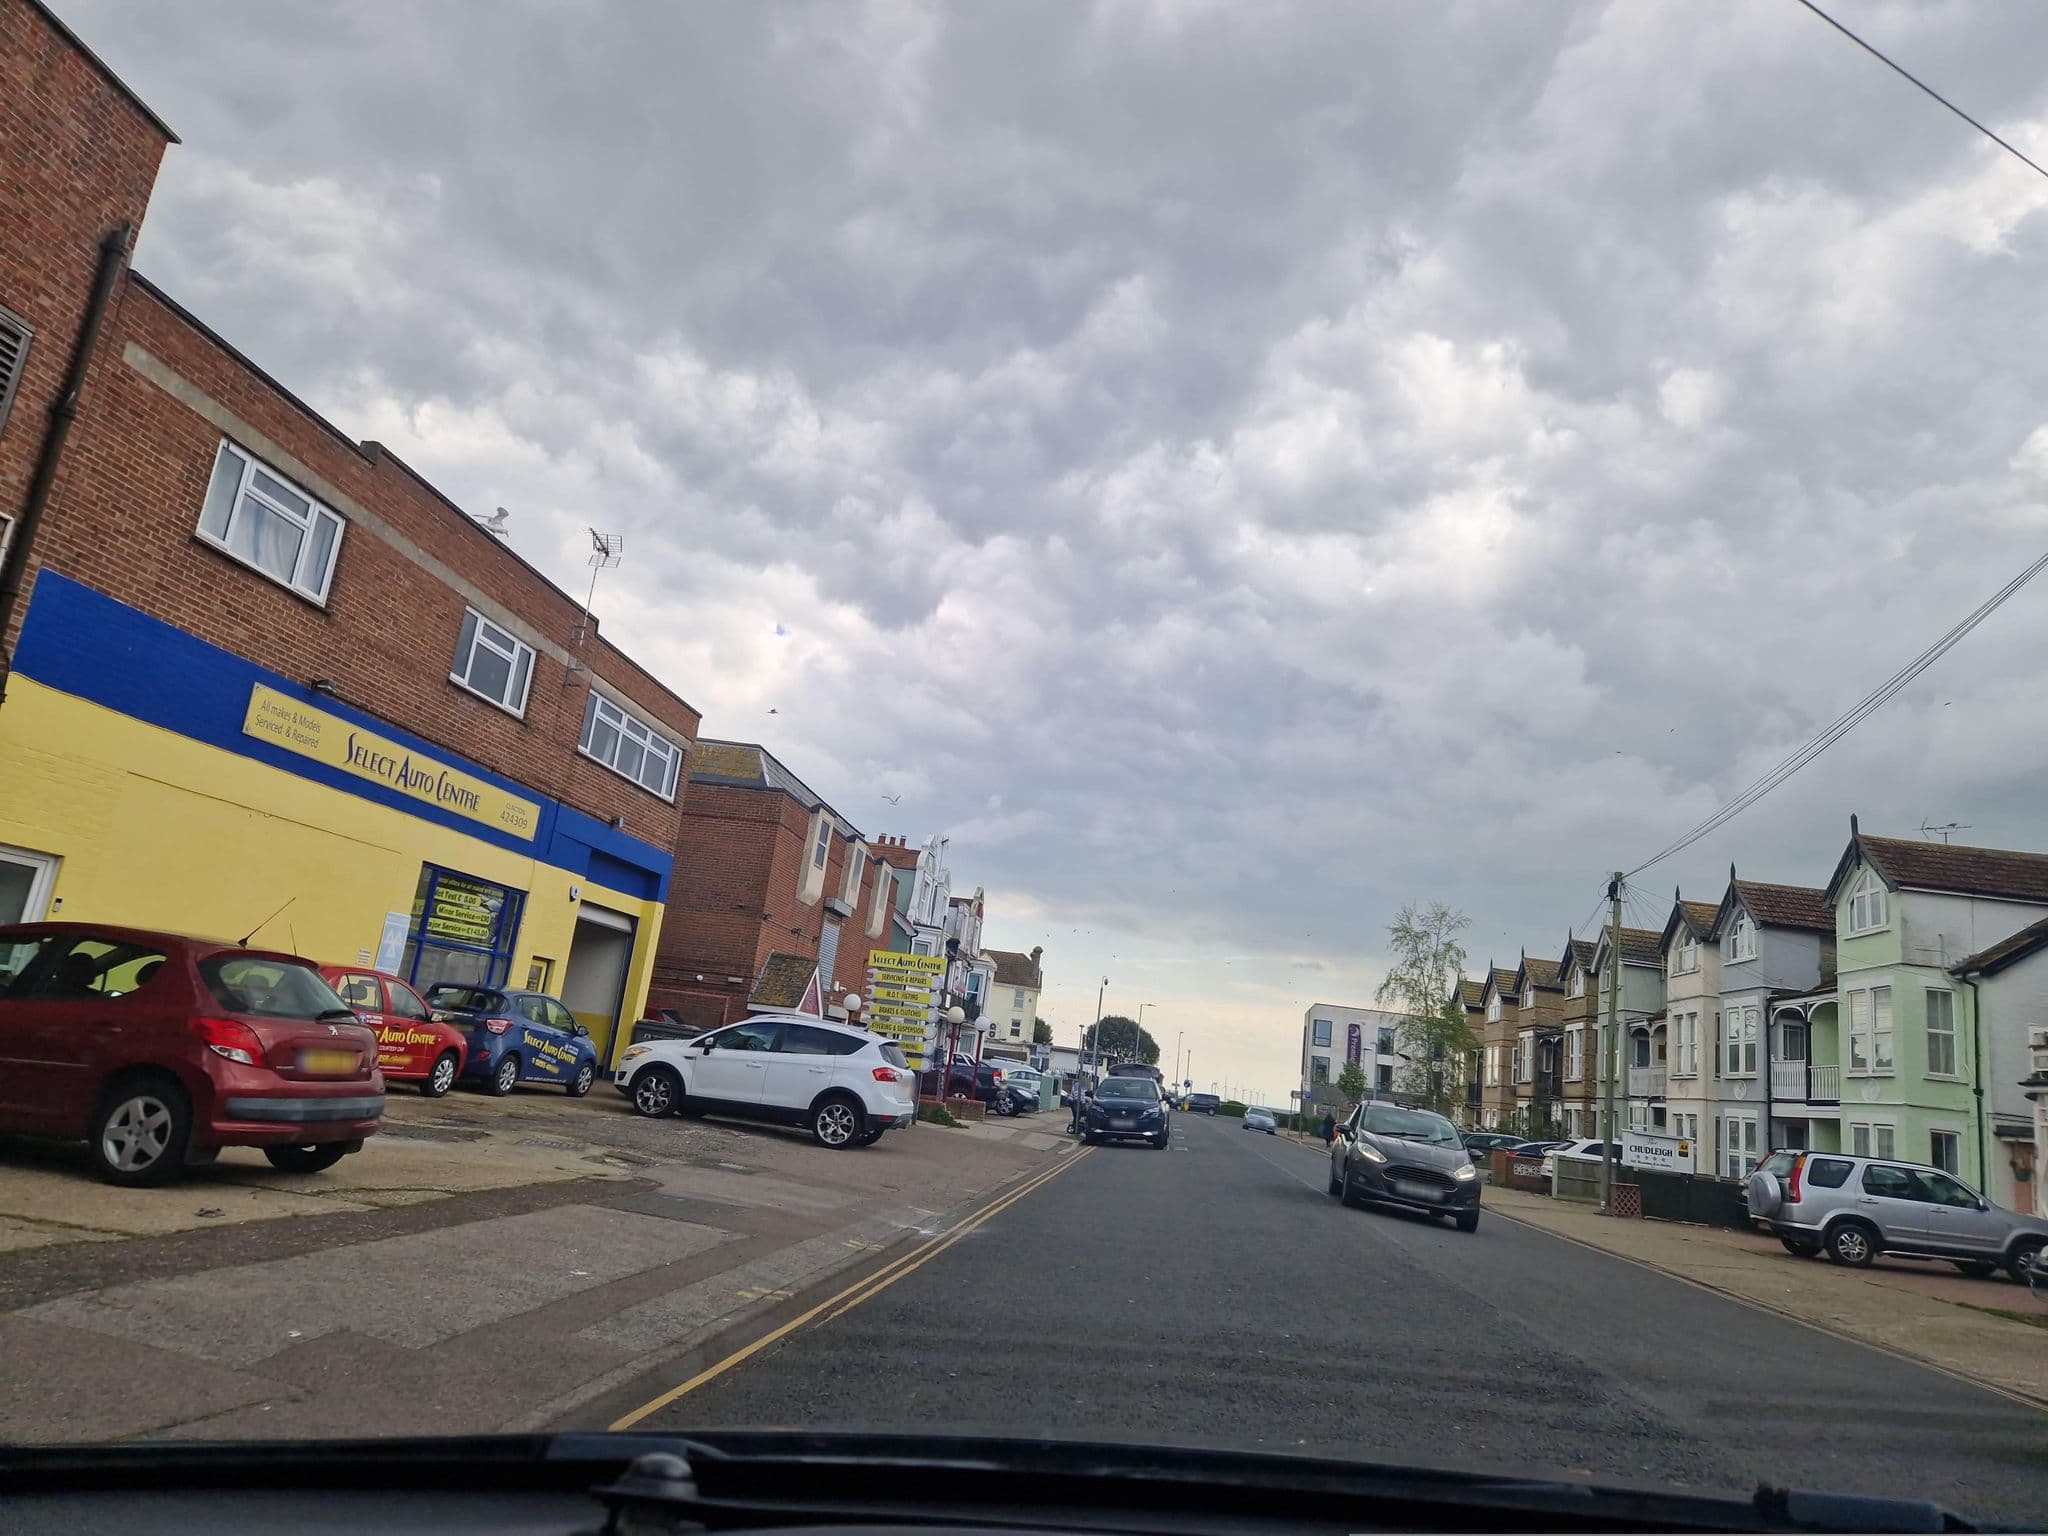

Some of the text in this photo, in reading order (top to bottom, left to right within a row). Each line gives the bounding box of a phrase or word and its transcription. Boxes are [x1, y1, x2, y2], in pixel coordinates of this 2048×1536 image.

[261, 699, 321, 733] All makes & Models
[255, 714, 319, 749] Serviced & Repaired
[343, 732, 481, 812] SELECT AUTO CENTRE
[500, 810, 528, 829] 424309
[455, 909, 475, 920] Service
[429, 921, 442, 929] ajor
[442, 922, 461, 931] Service
[873, 953, 941, 970] SELECT AUTO CENTRE
[881, 973, 927, 985] SERVICING & REPAIRS
[878, 1006, 895, 1015] BRAKES
[379, 1026, 405, 1043] AUTO
[406, 1028, 436, 1045] CENTRE
[871, 1022, 925, 1035] STEERING & SUSPENSION
[523, 1030, 544, 1050] SELECT
[541, 1040, 558, 1056] AUTO
[557, 1046, 577, 1064] CENTRE
[1629, 1144, 1673, 1157] CHUDLEIGH
